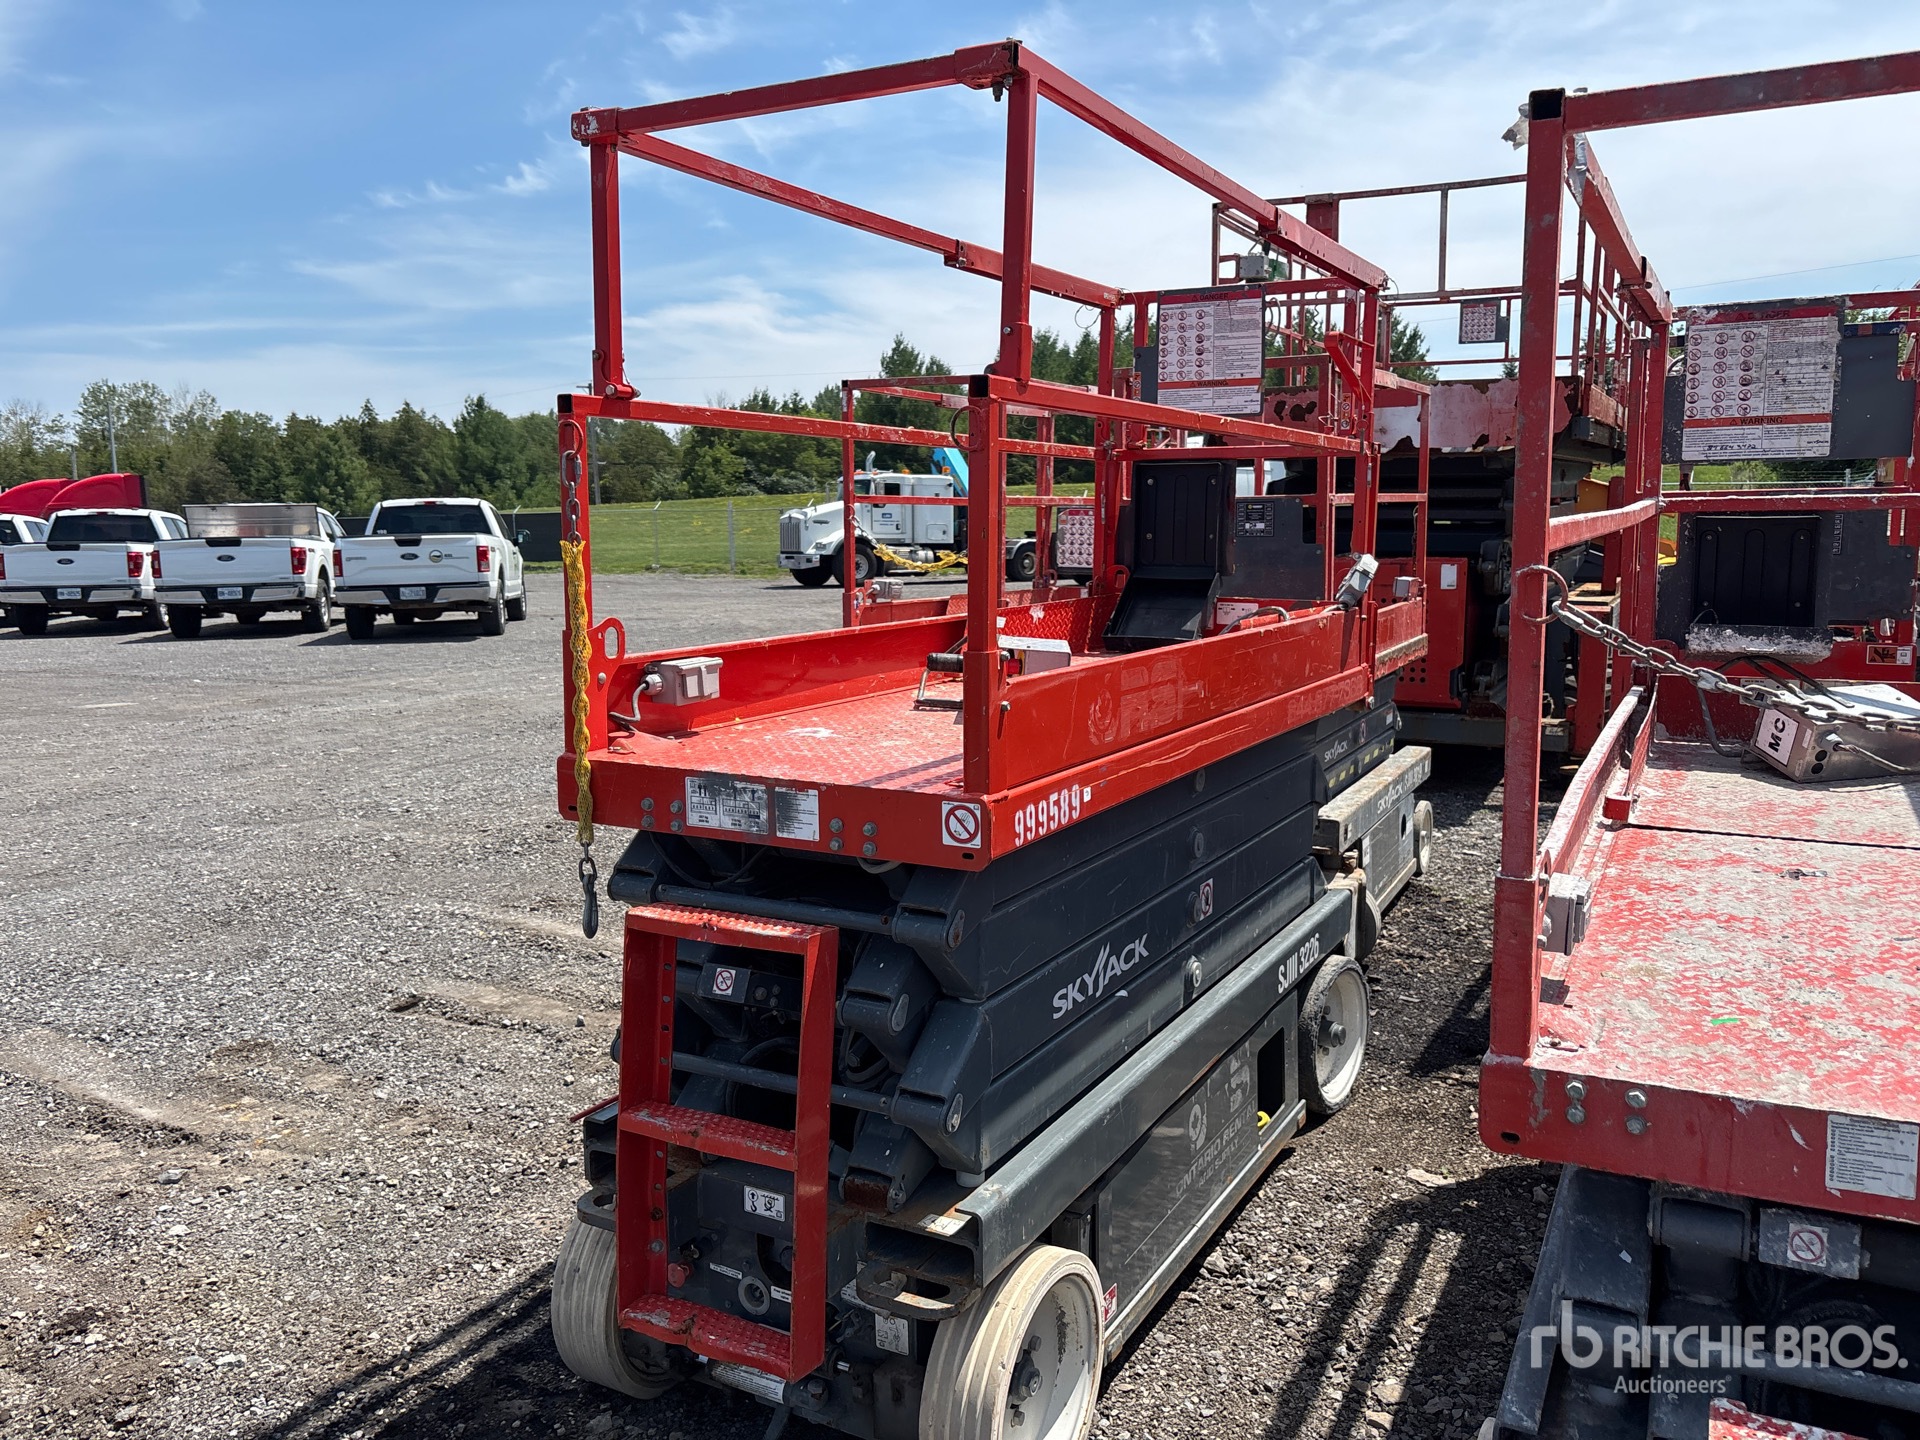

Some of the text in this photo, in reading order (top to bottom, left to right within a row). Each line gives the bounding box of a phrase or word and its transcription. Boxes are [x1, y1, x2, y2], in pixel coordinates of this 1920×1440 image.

[1740, 416, 1783, 425] WARNING
[1324, 740, 1348, 763] SKYJACK
[1014, 784, 1080, 848] 999589
[1052, 933, 1150, 1020] SKYJACK
[1299, 933, 1320, 978] 3226
